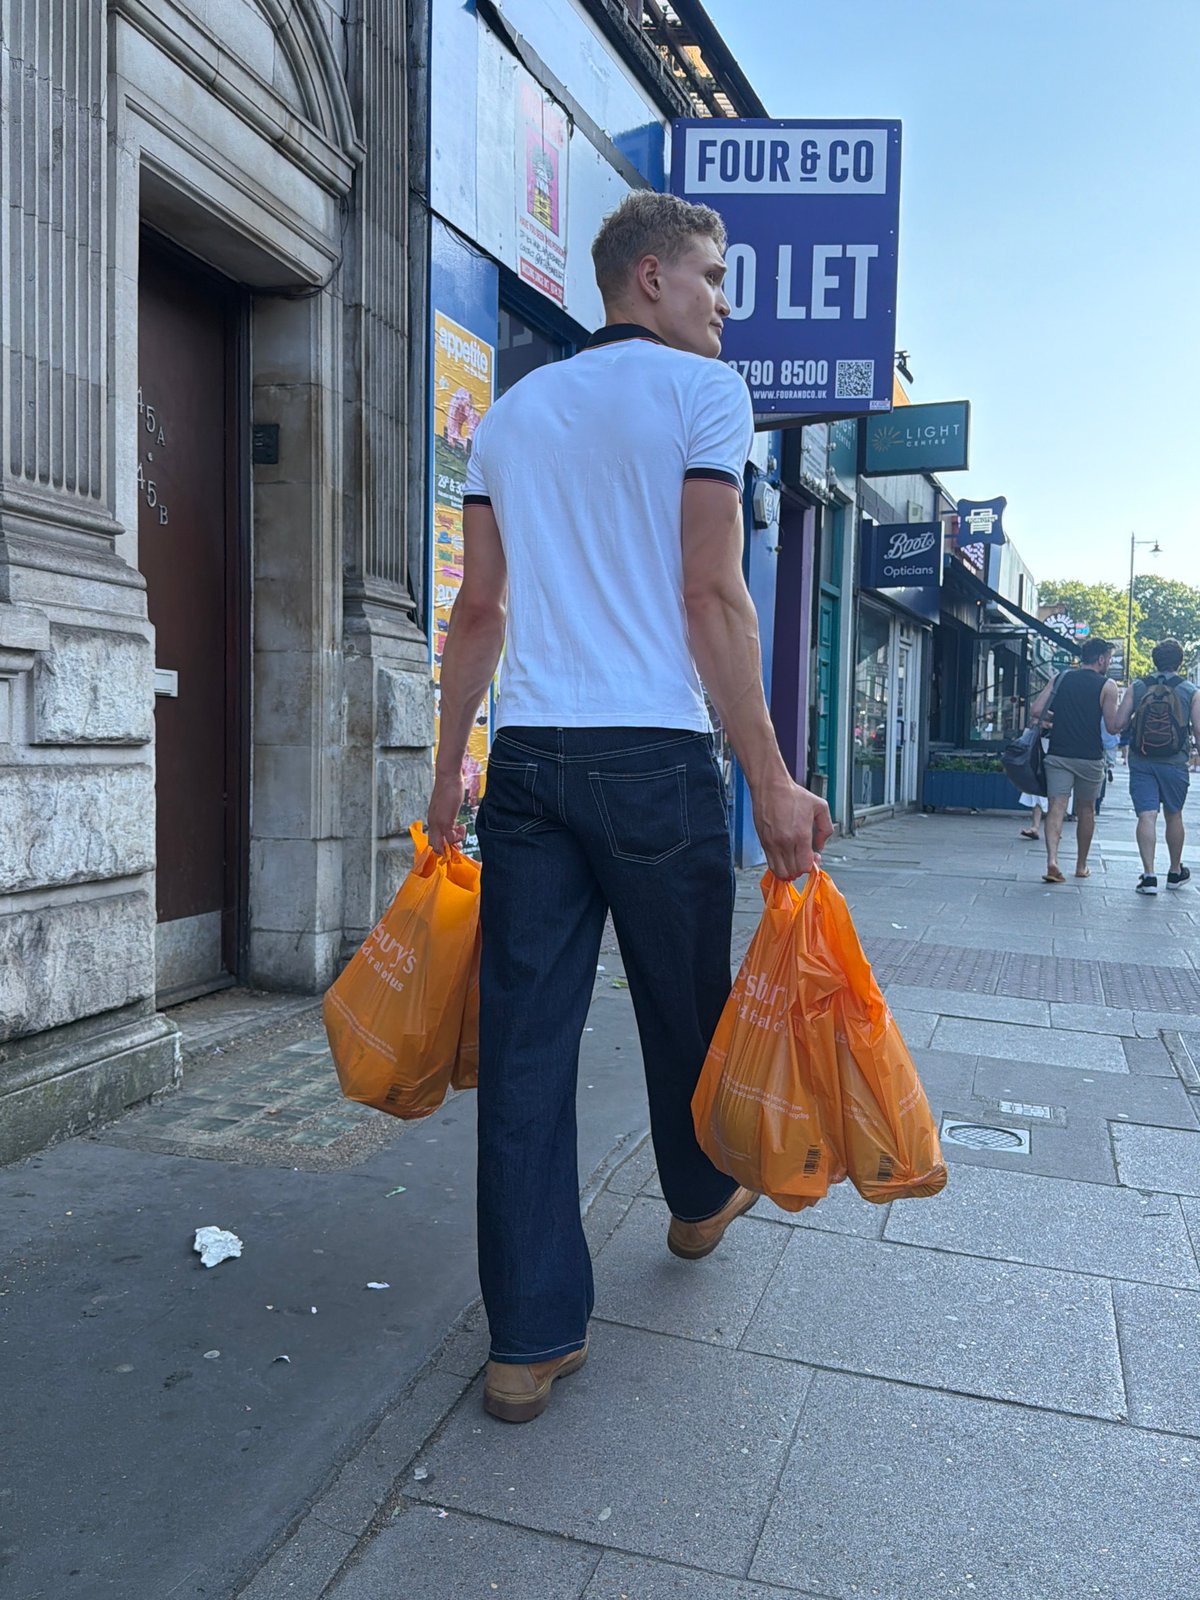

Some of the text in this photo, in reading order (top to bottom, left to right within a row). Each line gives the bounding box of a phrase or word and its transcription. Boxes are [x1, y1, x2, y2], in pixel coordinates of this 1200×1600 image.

[697, 139, 874, 183] FOUR & CO
[723, 243, 879, 321] O LET
[727, 360, 829, 386] 790 8500
[752, 390, 827, 399] WWW.FOURANDCO.UK
[906, 424, 960, 439] LIGHT
[884, 532, 935, 559] Boots
[883, 565, 934, 579] Opticians
